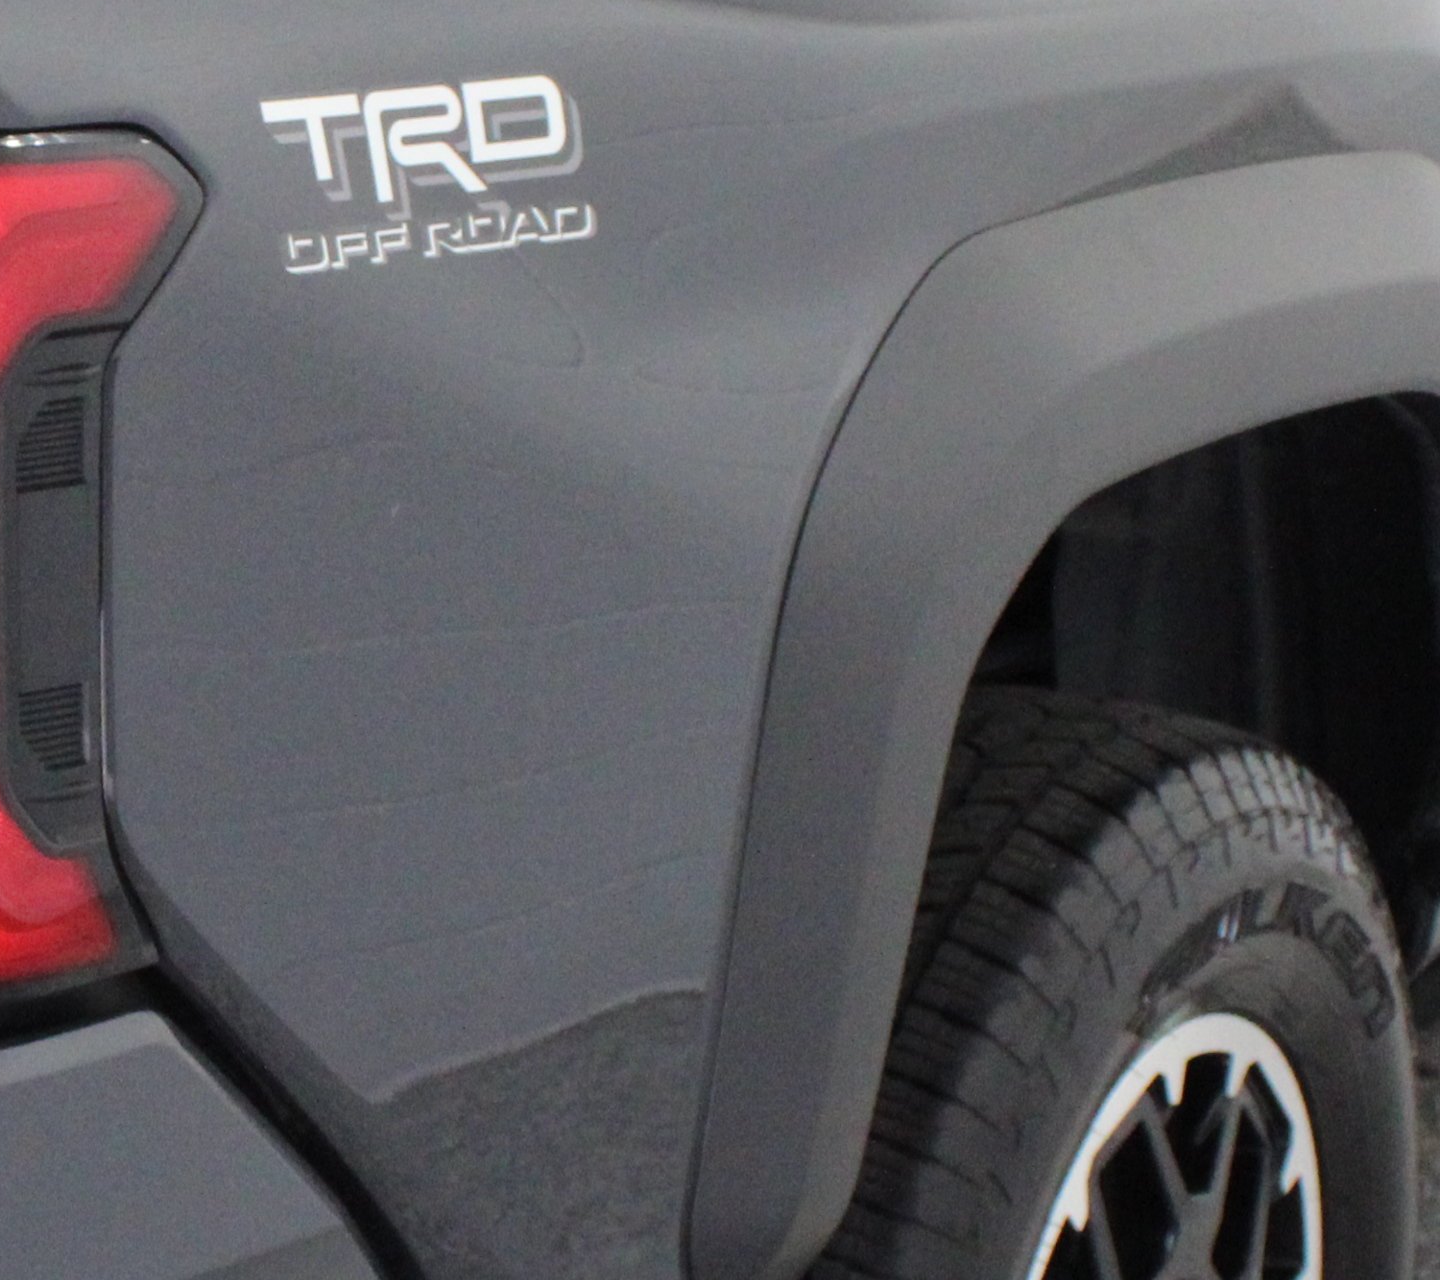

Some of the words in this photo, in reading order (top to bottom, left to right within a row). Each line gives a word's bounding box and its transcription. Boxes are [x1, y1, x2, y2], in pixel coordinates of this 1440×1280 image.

[260, 74, 579, 214] TRD
[284, 223, 412, 275] OFF
[423, 203, 598, 259] ROAD
